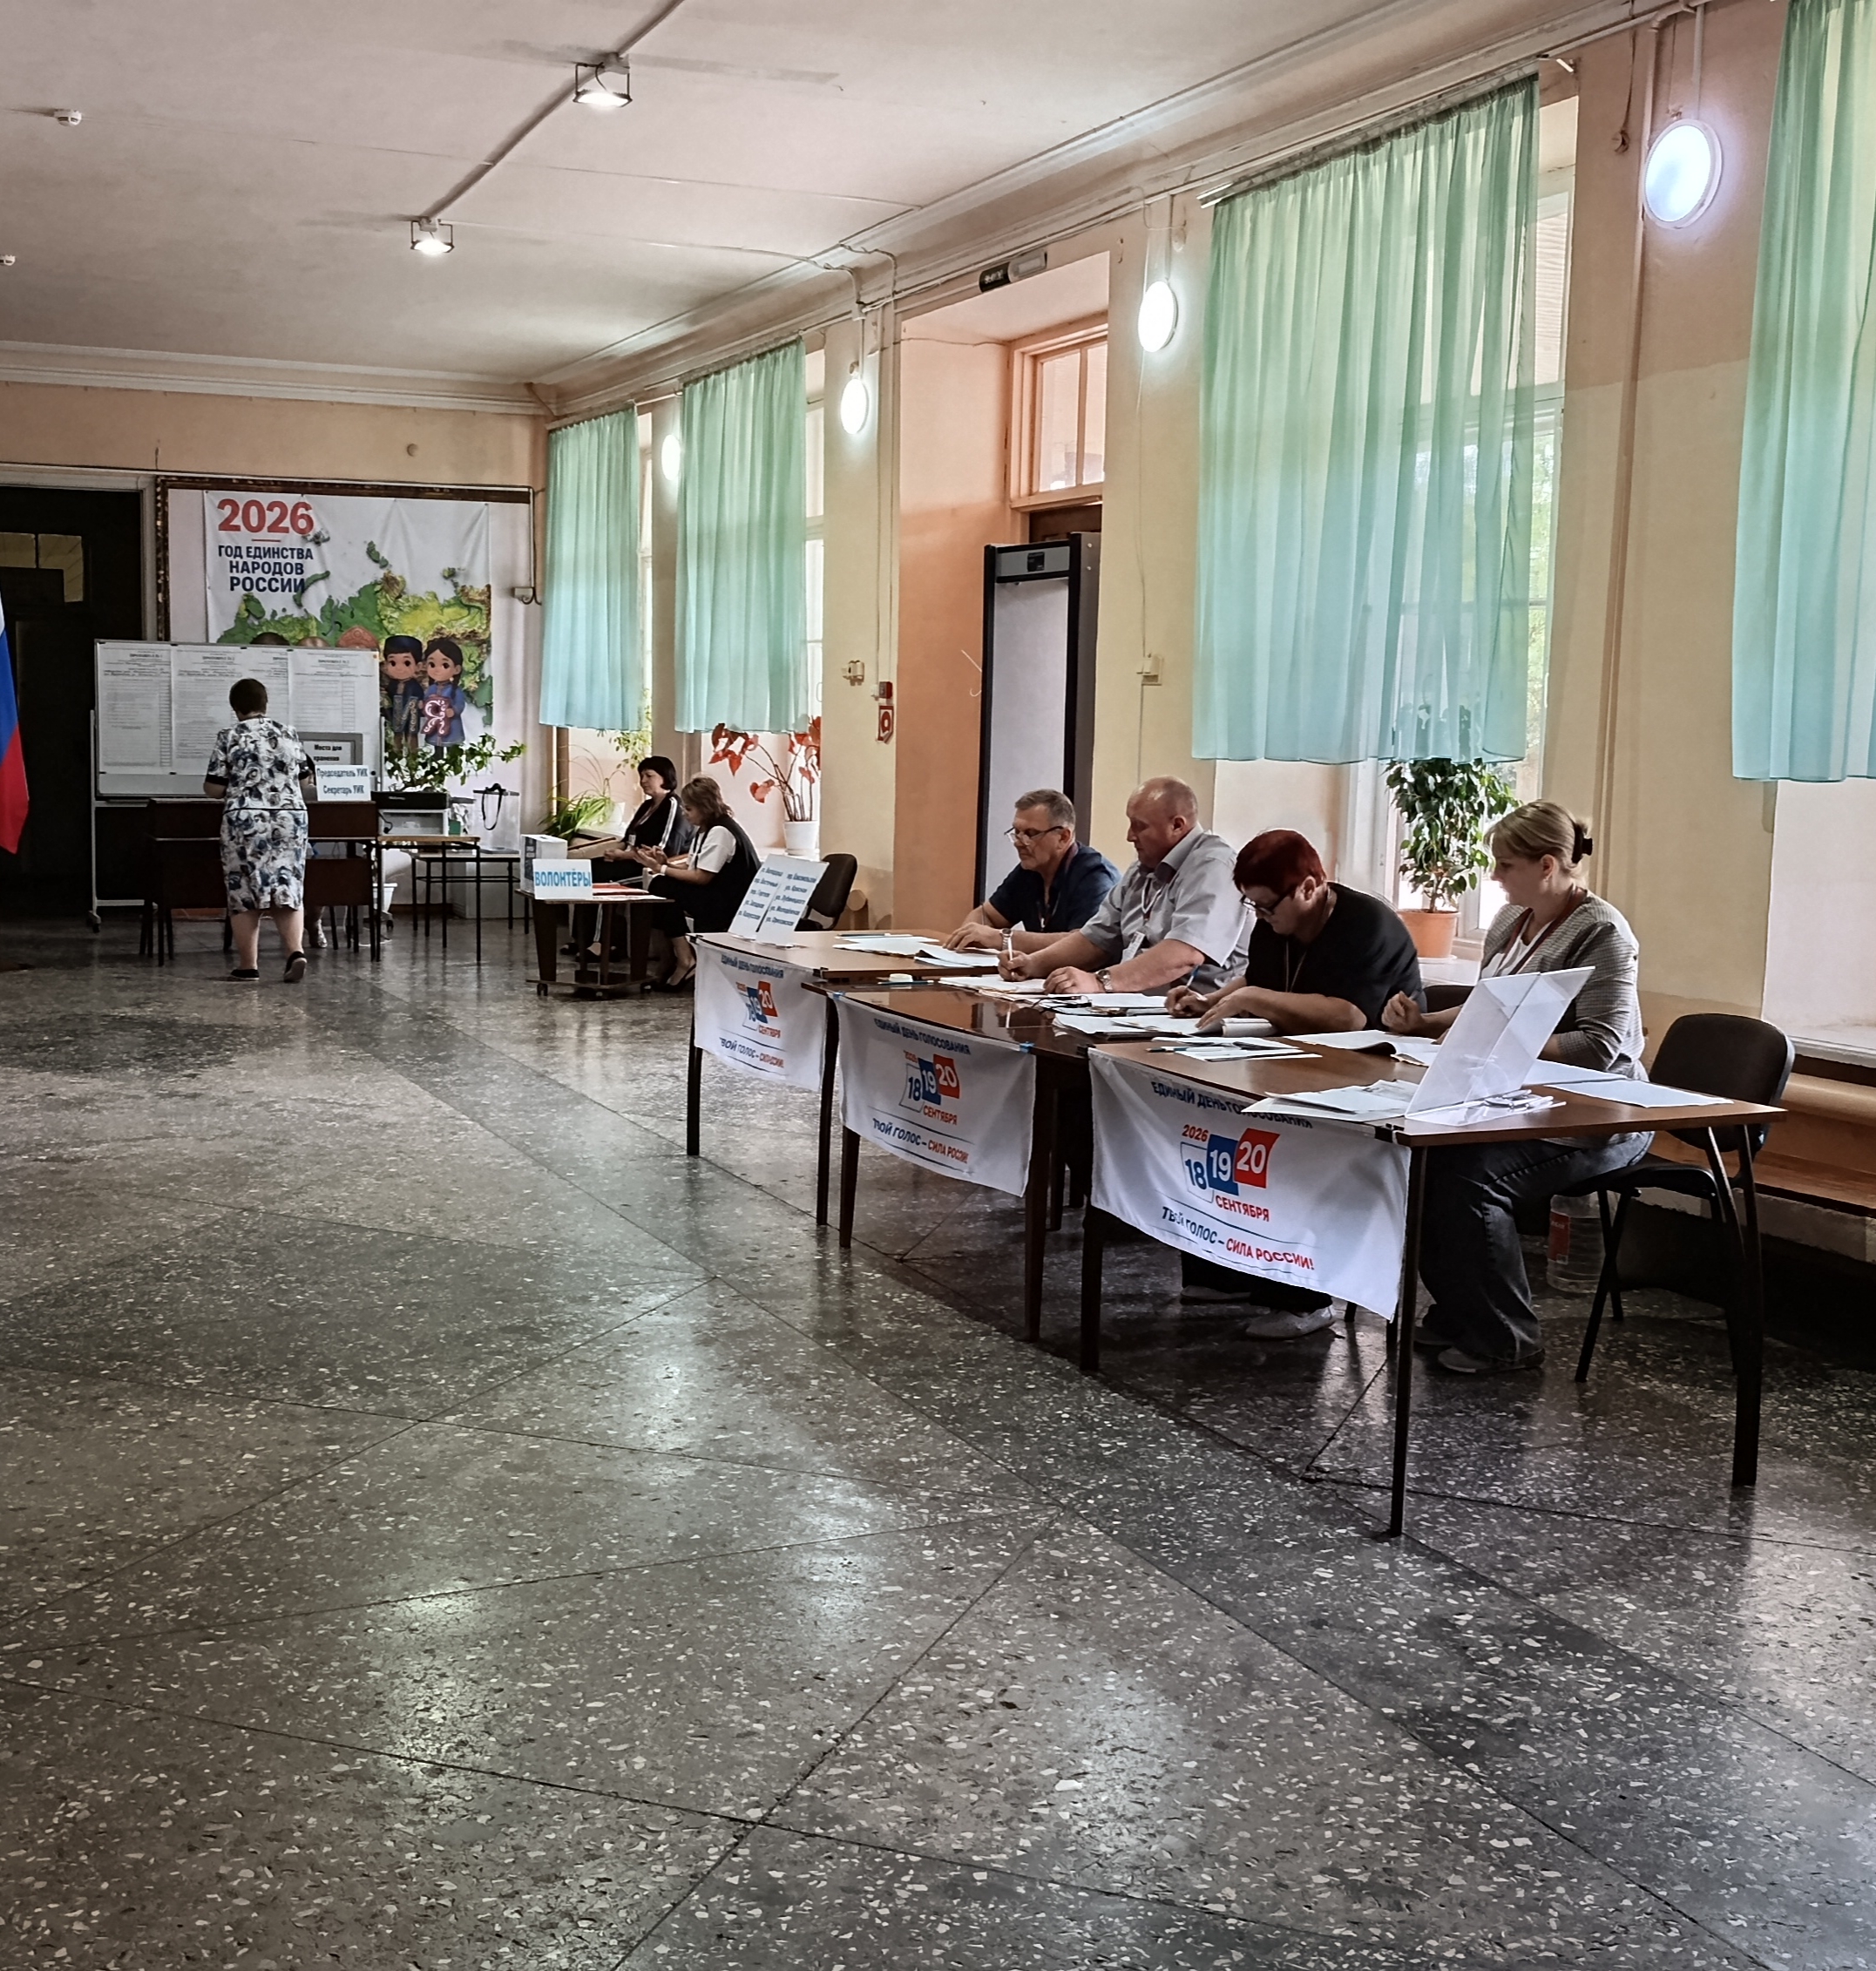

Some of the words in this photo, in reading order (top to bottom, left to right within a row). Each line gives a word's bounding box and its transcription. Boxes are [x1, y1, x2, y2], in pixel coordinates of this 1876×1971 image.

[217, 498, 315, 535] 2026
[218, 545, 244, 559] ГОД
[246, 545, 315, 560] ЕДИНСТВА
[229, 560, 305, 576] НАРОДОВ
[229, 576, 305, 593] РОССИИ
[758, 989, 774, 1009] 20
[908, 1076, 921, 1101] 18
[922, 1069, 936, 1094] 19
[935, 1063, 958, 1087] 20
[1151, 1081, 1195, 1105] ЕДИНЫЙ
[1197, 1094, 1227, 1111] ДЕНЬ
[924, 1105, 958, 1126] СЕНТЯБРЯ
[892, 1127, 922, 1146] ГОЛОС
[927, 1140, 946, 1156] СИЛА
[1182, 1124, 1209, 1142] 2026
[1184, 1158, 1207, 1190] 18
[1209, 1149, 1231, 1182] 19
[1236, 1141, 1267, 1174] 20
[1216, 1195, 1270, 1222] СЕНТЯБРЯ
[1185, 1218, 1218, 1244] ГОЛОС
[1226, 1238, 1254, 1260] СИЛА
[1255, 1248, 1315, 1270] РОССИИ!
